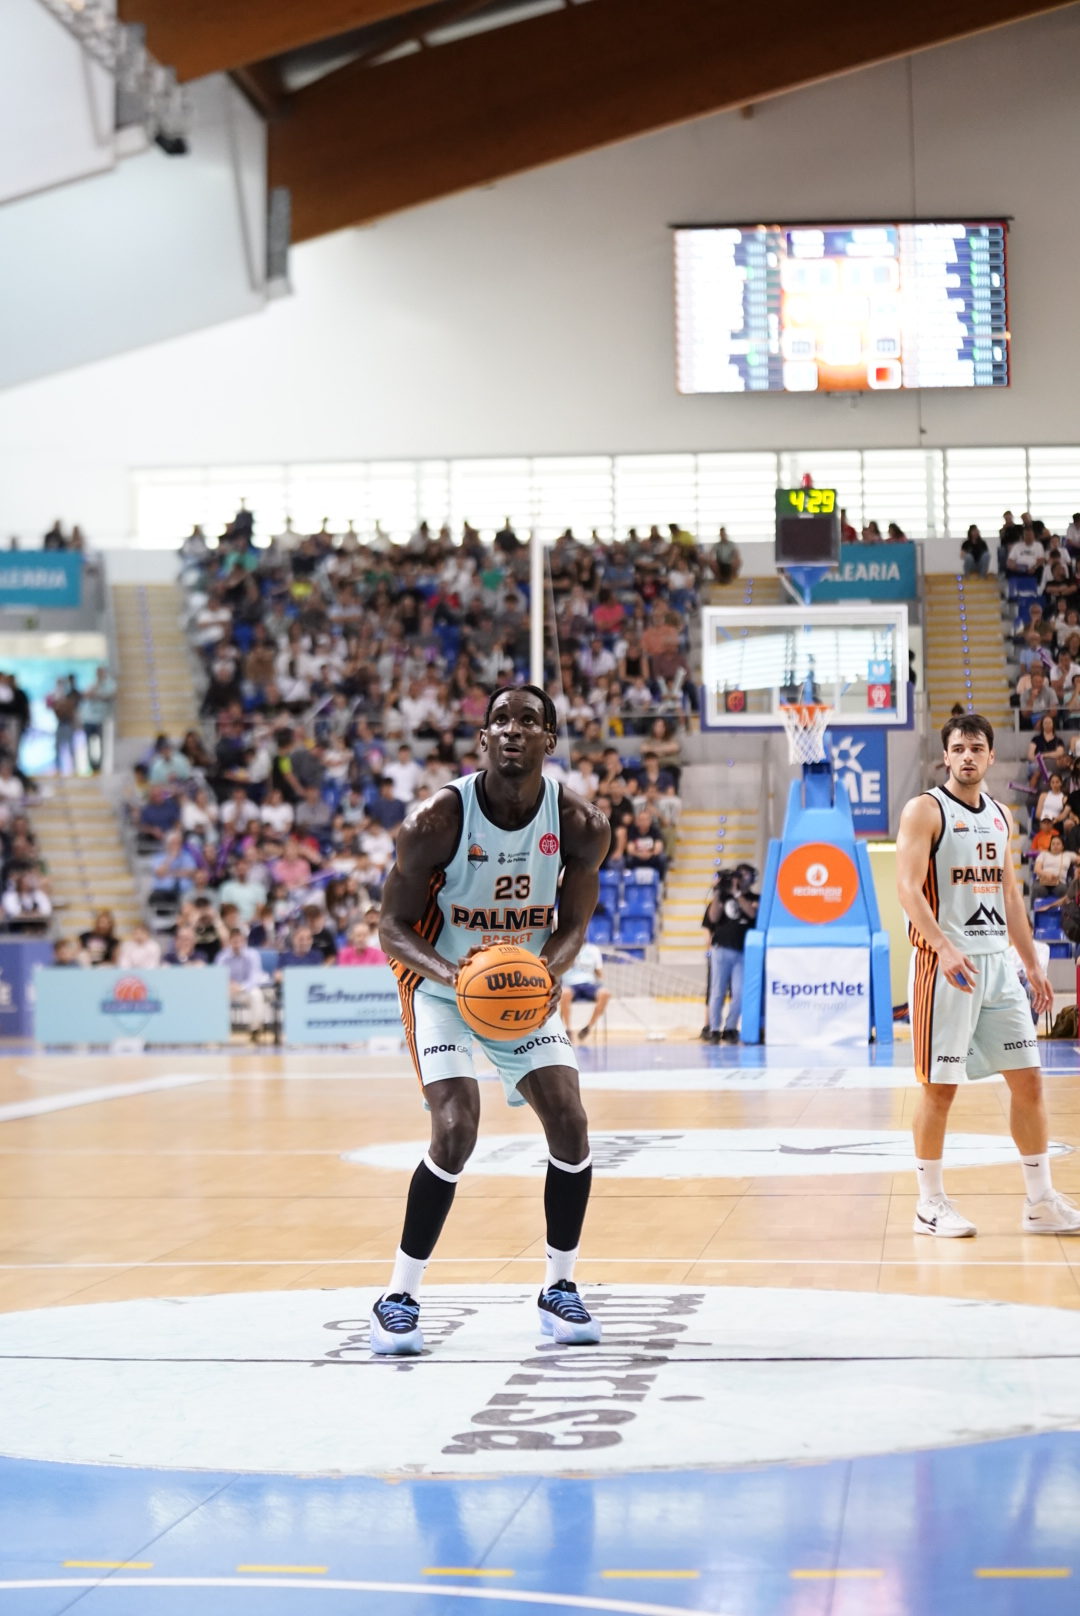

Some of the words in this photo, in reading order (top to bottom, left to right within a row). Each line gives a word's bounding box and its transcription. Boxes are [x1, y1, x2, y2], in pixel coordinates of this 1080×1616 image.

[976, 842, 997, 861] 15
[494, 875, 531, 900] 23
[481, 932, 534, 945] BASKET
[485, 970, 547, 991] Wilson
[772, 981, 864, 999] EsportNet
